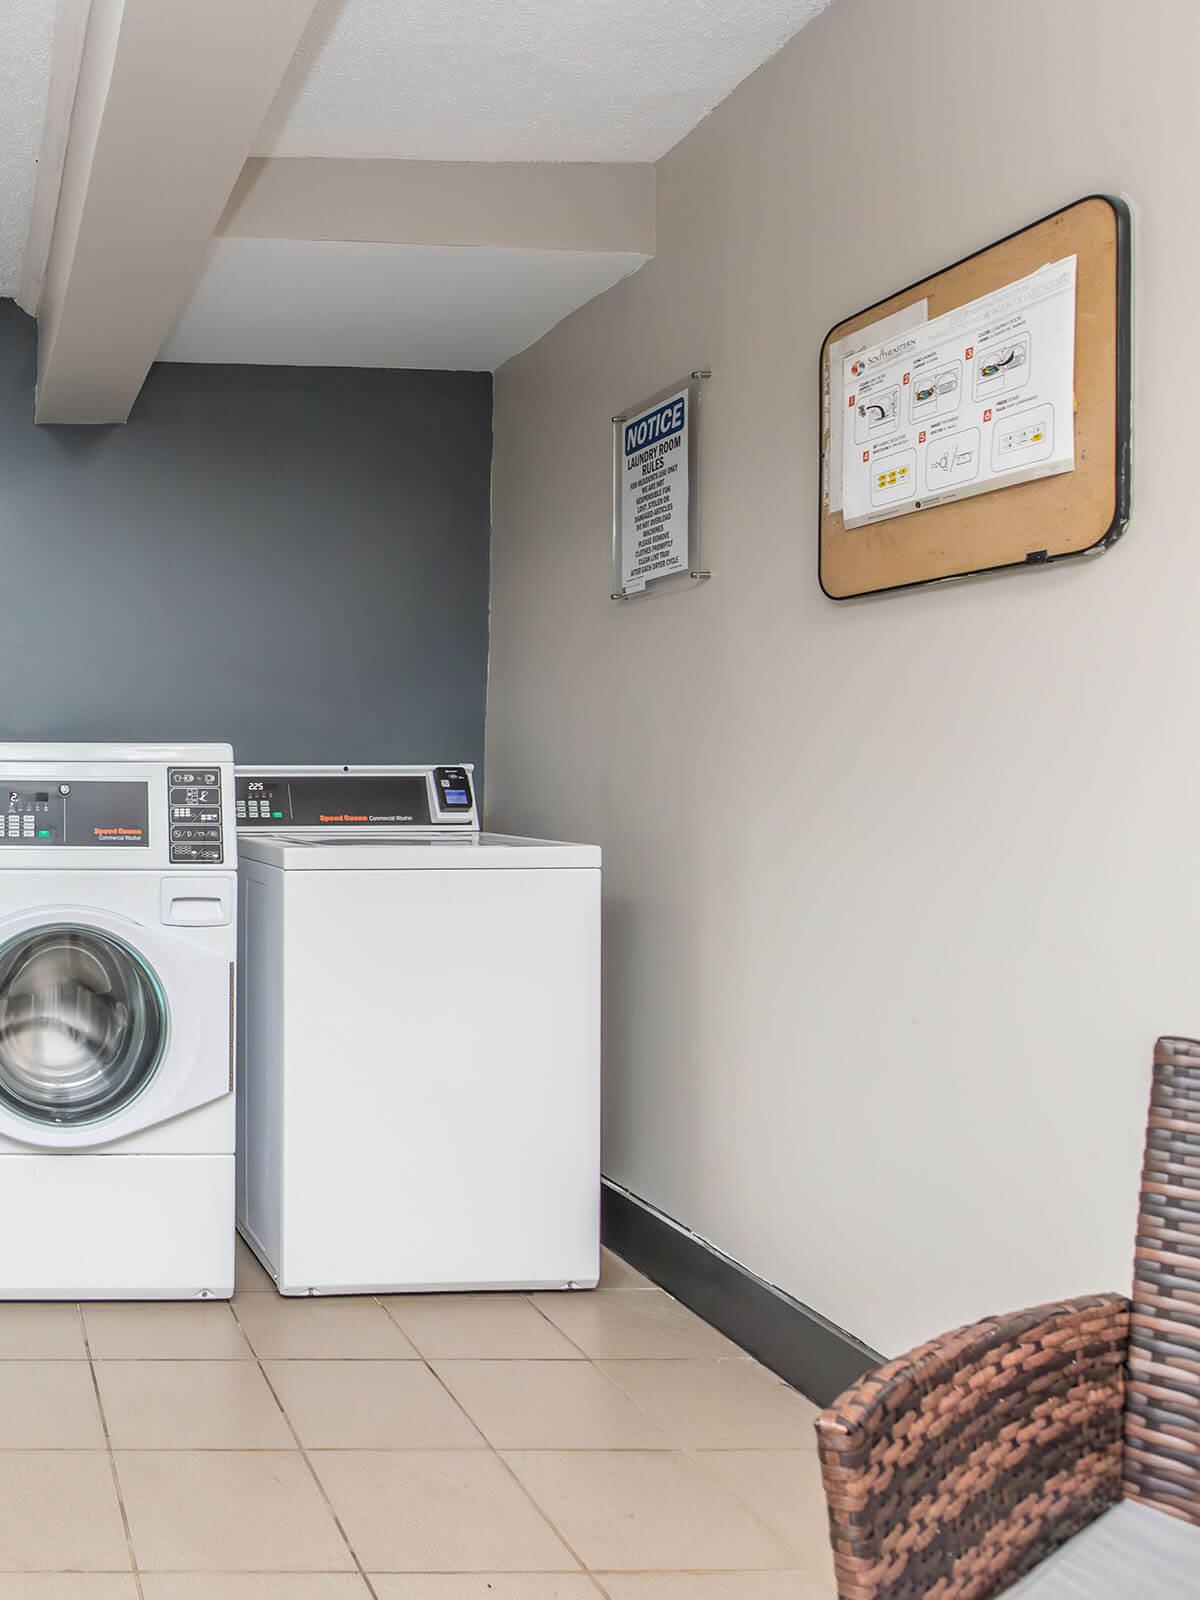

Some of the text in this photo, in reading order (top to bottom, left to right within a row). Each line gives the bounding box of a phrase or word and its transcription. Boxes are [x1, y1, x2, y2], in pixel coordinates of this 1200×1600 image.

[627, 402, 683, 451] NOTICE
[628, 436, 681, 470] LAUNDRY ROOM
[642, 457, 664, 476] RULES
[667, 464, 678, 474] ONLY
[637, 485, 671, 504] RESPONSIBLE FOR
[648, 498, 662, 509] STOLEN
[635, 503, 673, 523] DAMAGED ARTICLES
[650, 513, 671, 526] OVERLOAD
[638, 531, 669, 548] PLEASE REMOVE
[643, 525, 663, 537] MACHINES
[635, 539, 673, 557] CLOTHES PROMPTLY
[631, 568, 641, 576] AFTER
[642, 565, 651, 573] EACH
[653, 561, 665, 569] DRYER
[666, 556, 679, 565] CYCLE
[639, 550, 669, 565] CLEAN LINT TRAY
[248, 782, 264, 790] 225
